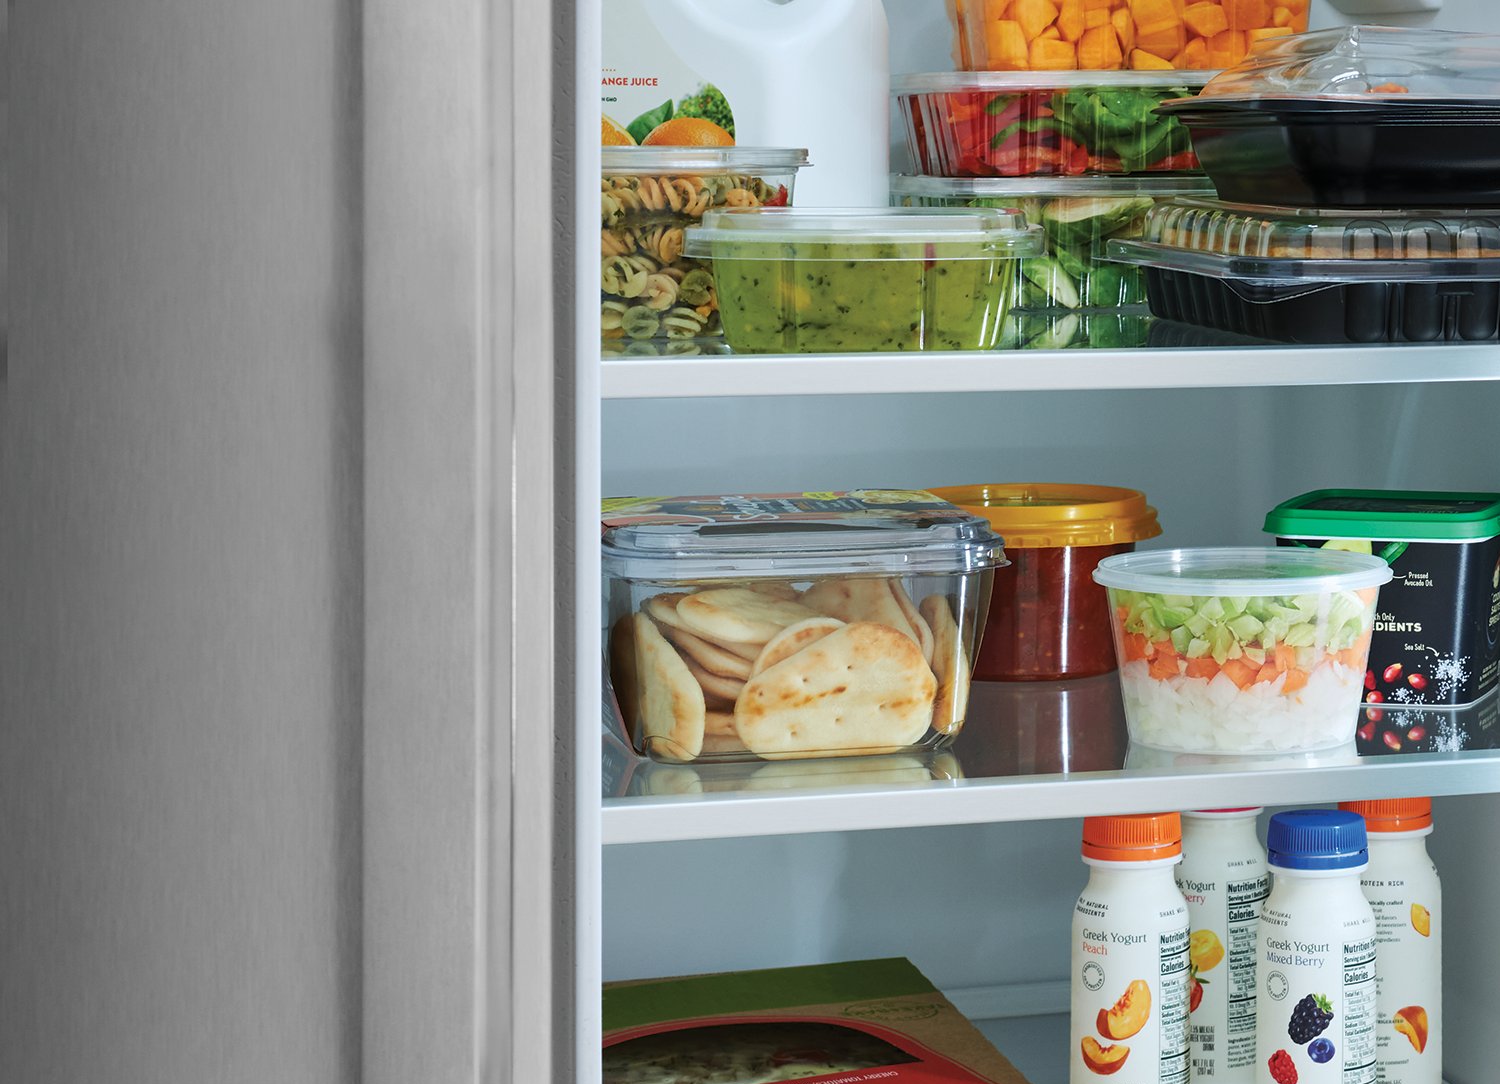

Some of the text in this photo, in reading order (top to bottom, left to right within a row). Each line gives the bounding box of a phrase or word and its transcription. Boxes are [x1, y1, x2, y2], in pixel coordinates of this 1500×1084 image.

[630, 77, 658, 86] JUICE
[1185, 880, 1216, 892] Yogurt
[1228, 881, 1256, 892] Nutrition
[1228, 908, 1254, 920] Calories
[1082, 928, 1147, 945] Greek Yogurt
[1160, 932, 1185, 945] Nutrition
[1082, 941, 1108, 956] Peach
[1266, 936, 1330, 955] Greek Yogurt
[1343, 940, 1370, 954] Nutrition
[1160, 960, 1184, 973] Calories
[1266, 951, 1325, 969] Mixed Berry
[1344, 970, 1369, 983] Calories
[863, 1070, 899, 1081] CHERRY
